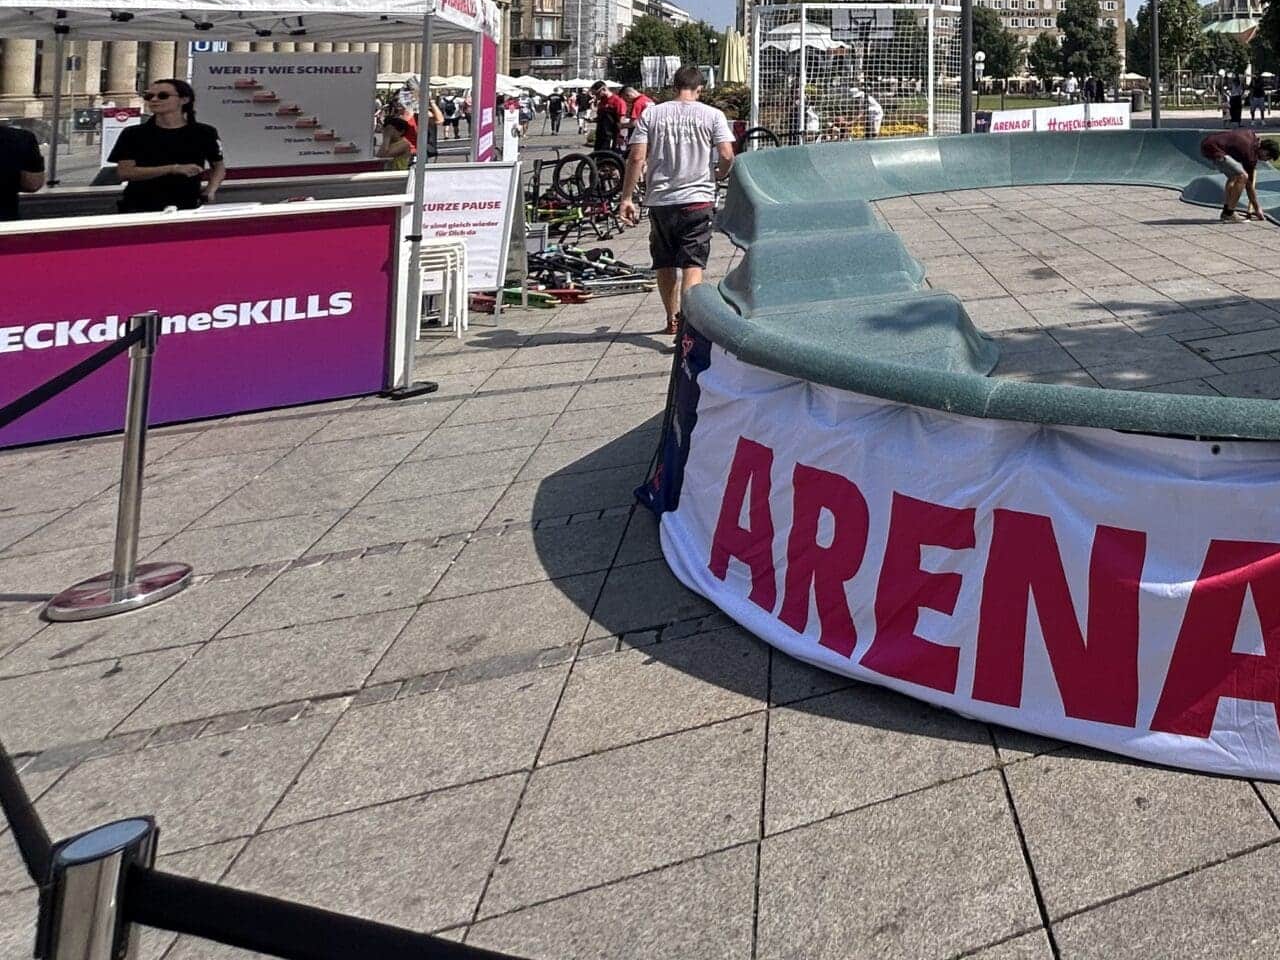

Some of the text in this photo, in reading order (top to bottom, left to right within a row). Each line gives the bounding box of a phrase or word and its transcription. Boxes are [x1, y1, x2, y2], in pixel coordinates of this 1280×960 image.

[208, 65, 363, 75] WER IST WIE SCHNELL?
[993, 120, 1021, 131] ARENA
[1021, 119, 1031, 129] OF
[461, 201, 502, 210] PAUSE
[448, 221, 471, 230] gleich
[0, 291, 353, 354] ECKdneSKILLS
